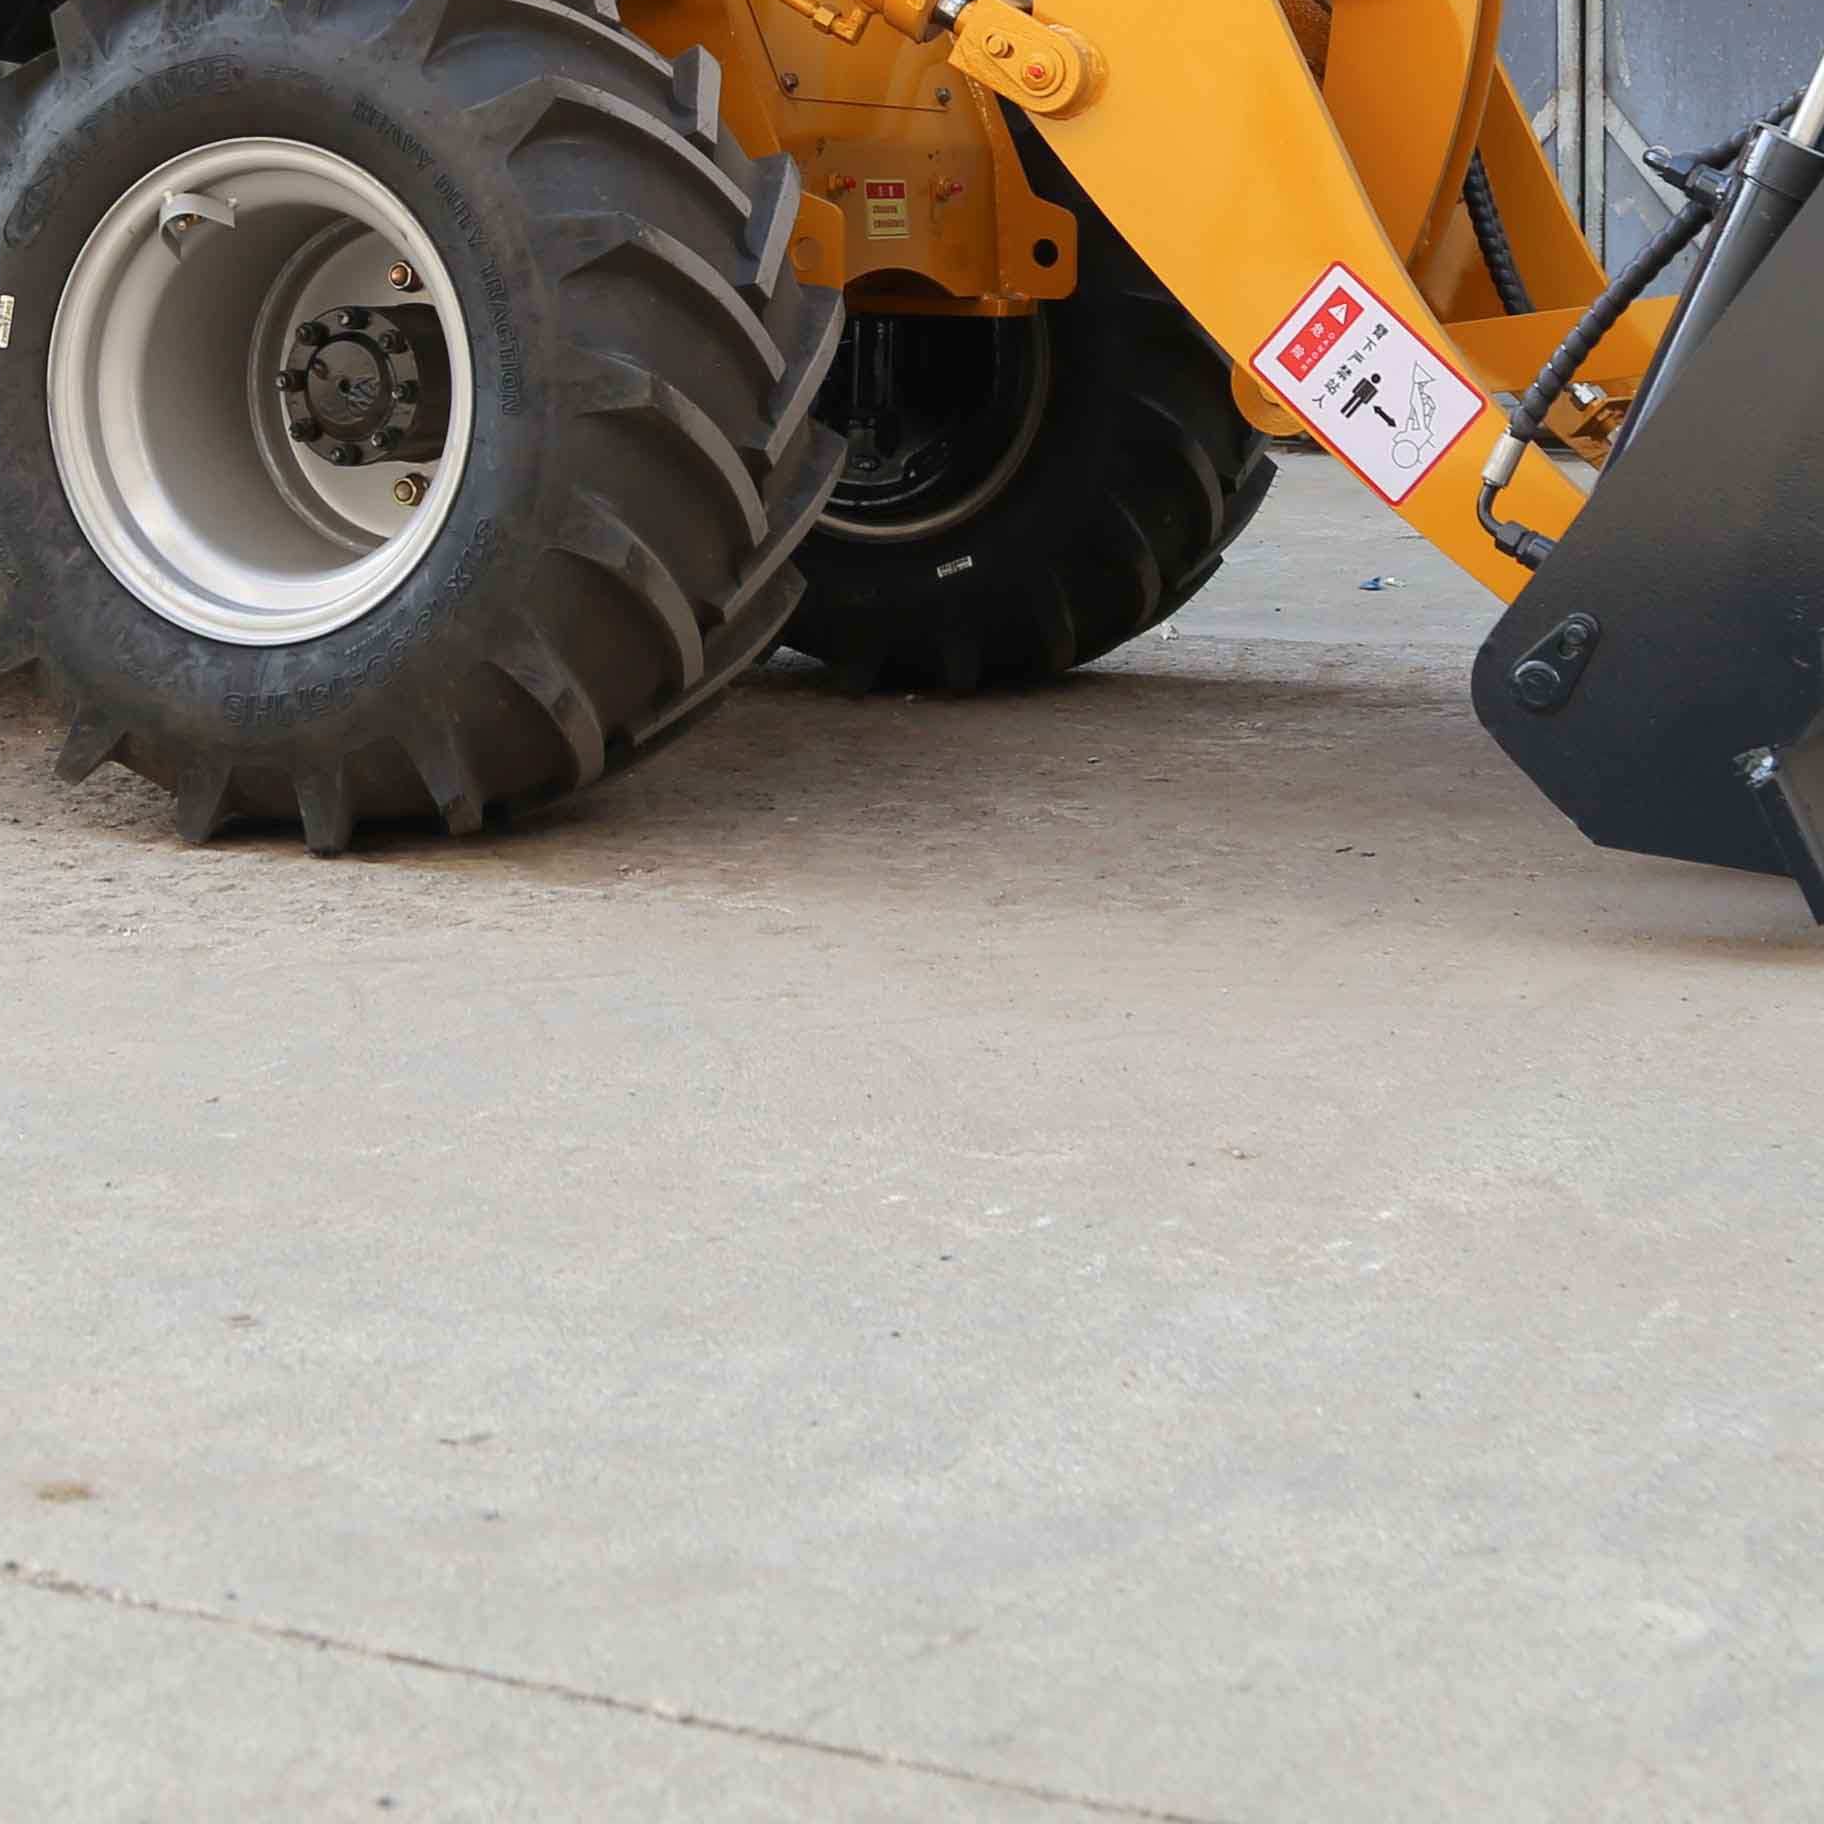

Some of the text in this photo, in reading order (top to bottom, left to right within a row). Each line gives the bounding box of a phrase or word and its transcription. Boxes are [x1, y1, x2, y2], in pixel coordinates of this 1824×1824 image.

[352, 94, 523, 415] HEAVY DUTY TRACTION
[1290, 322, 1325, 360] 危险
[1300, 333, 1336, 372] DANGER
